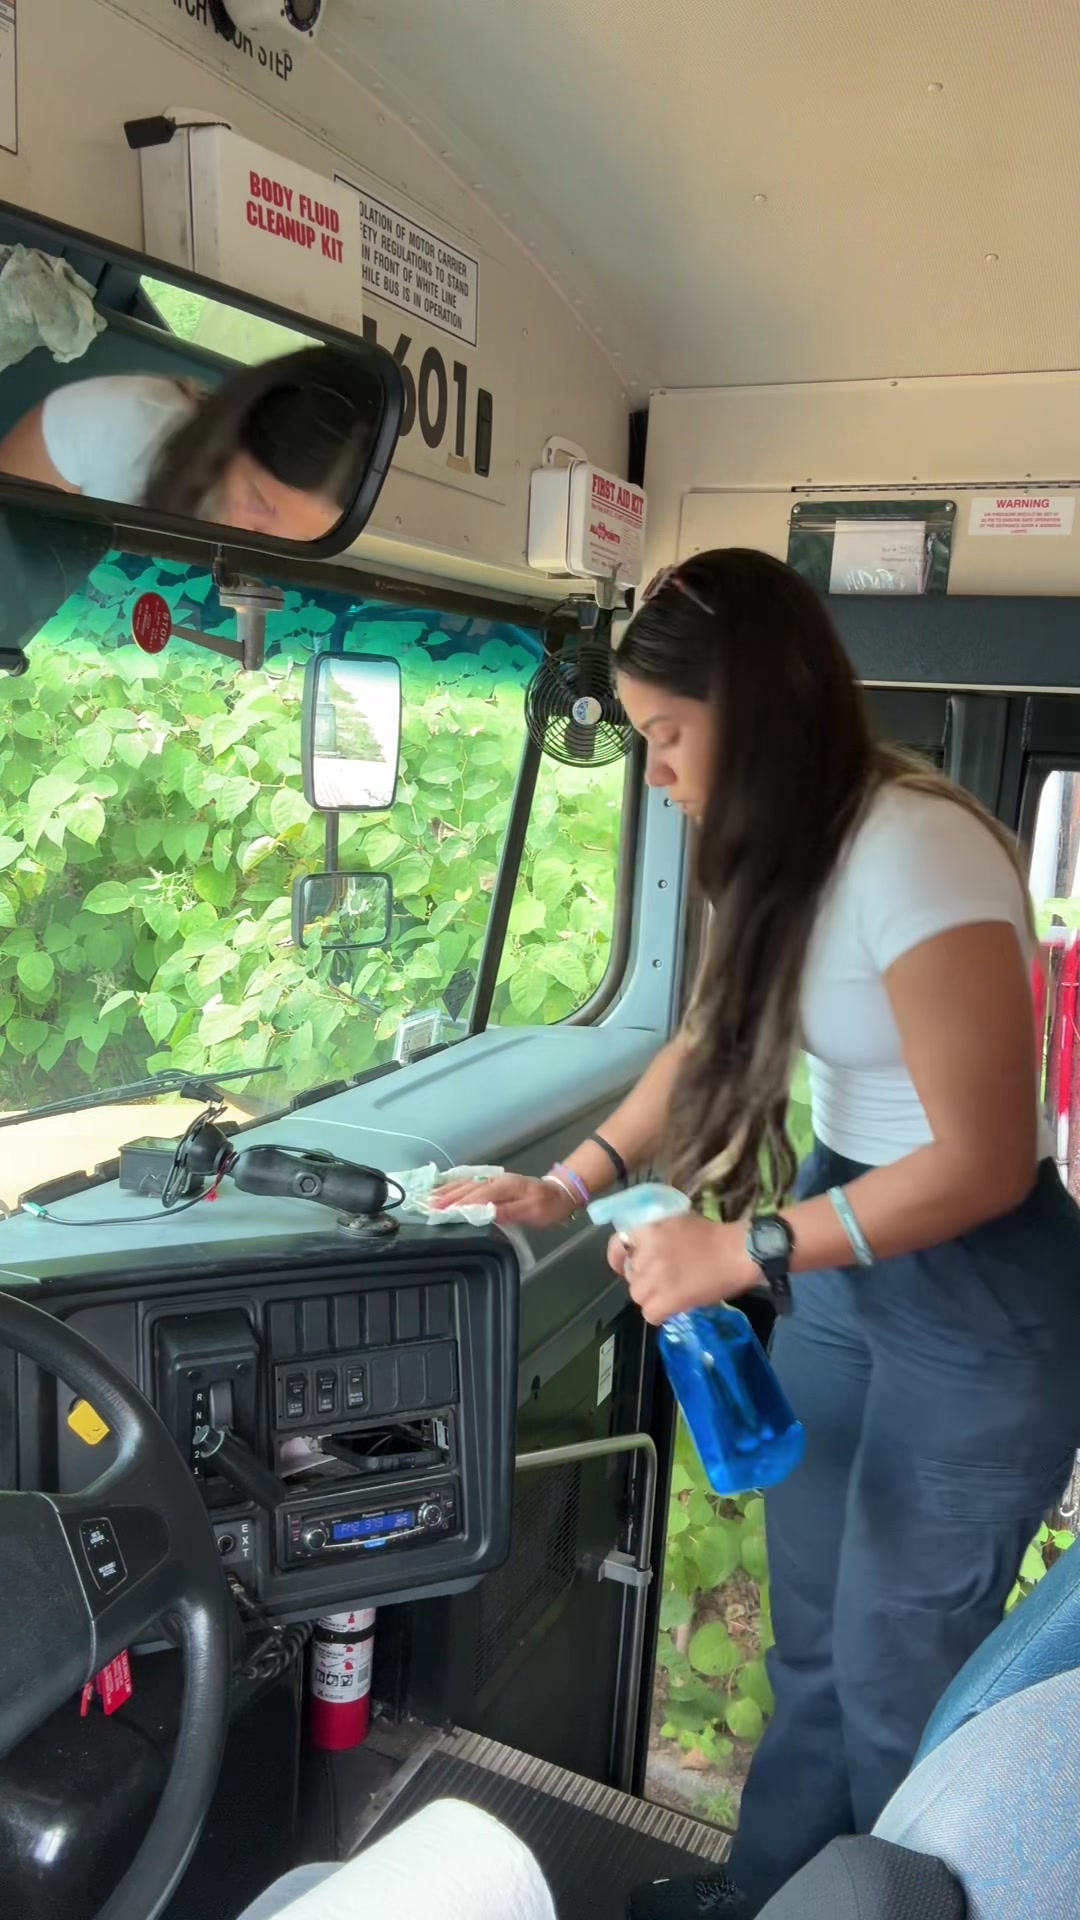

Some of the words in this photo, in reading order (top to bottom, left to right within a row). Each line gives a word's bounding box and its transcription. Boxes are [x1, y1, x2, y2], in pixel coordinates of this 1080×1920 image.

[249, 170, 293, 212] BODY
[299, 193, 340, 234] FLUID
[246, 200, 316, 249] CLEANUP
[321, 232, 344, 264] KIT
[395, 223, 406, 240] OF
[409, 231, 435, 259] MOTOR
[437, 249, 467, 277] CARRIER
[361, 244, 370, 262] IN
[373, 250, 400, 277] FRONT
[402, 267, 413, 284] OF
[416, 274, 439, 299] WHITE
[441, 287, 457, 309] LINE
[381, 234, 432, 276] REGULATIONS
[435, 266, 445, 284] TO
[448, 273, 469, 297] STAND
[383, 275, 400, 297] BUS
[402, 286, 410, 302] IS
[413, 291, 422, 308] IN
[423, 297, 463, 330] OPERATION
[591, 473, 616, 502] FIRST
[617, 486, 631, 509] AID
[631, 492, 644, 516] KIT
[996, 498, 1050, 509] WARNING
[160, 612, 170, 646] STOP
[195, 1411, 202, 1420] N
[196, 1393, 203, 1401] R
[193, 1466, 199, 1475] 1
[194, 1450, 200, 1458] 2
